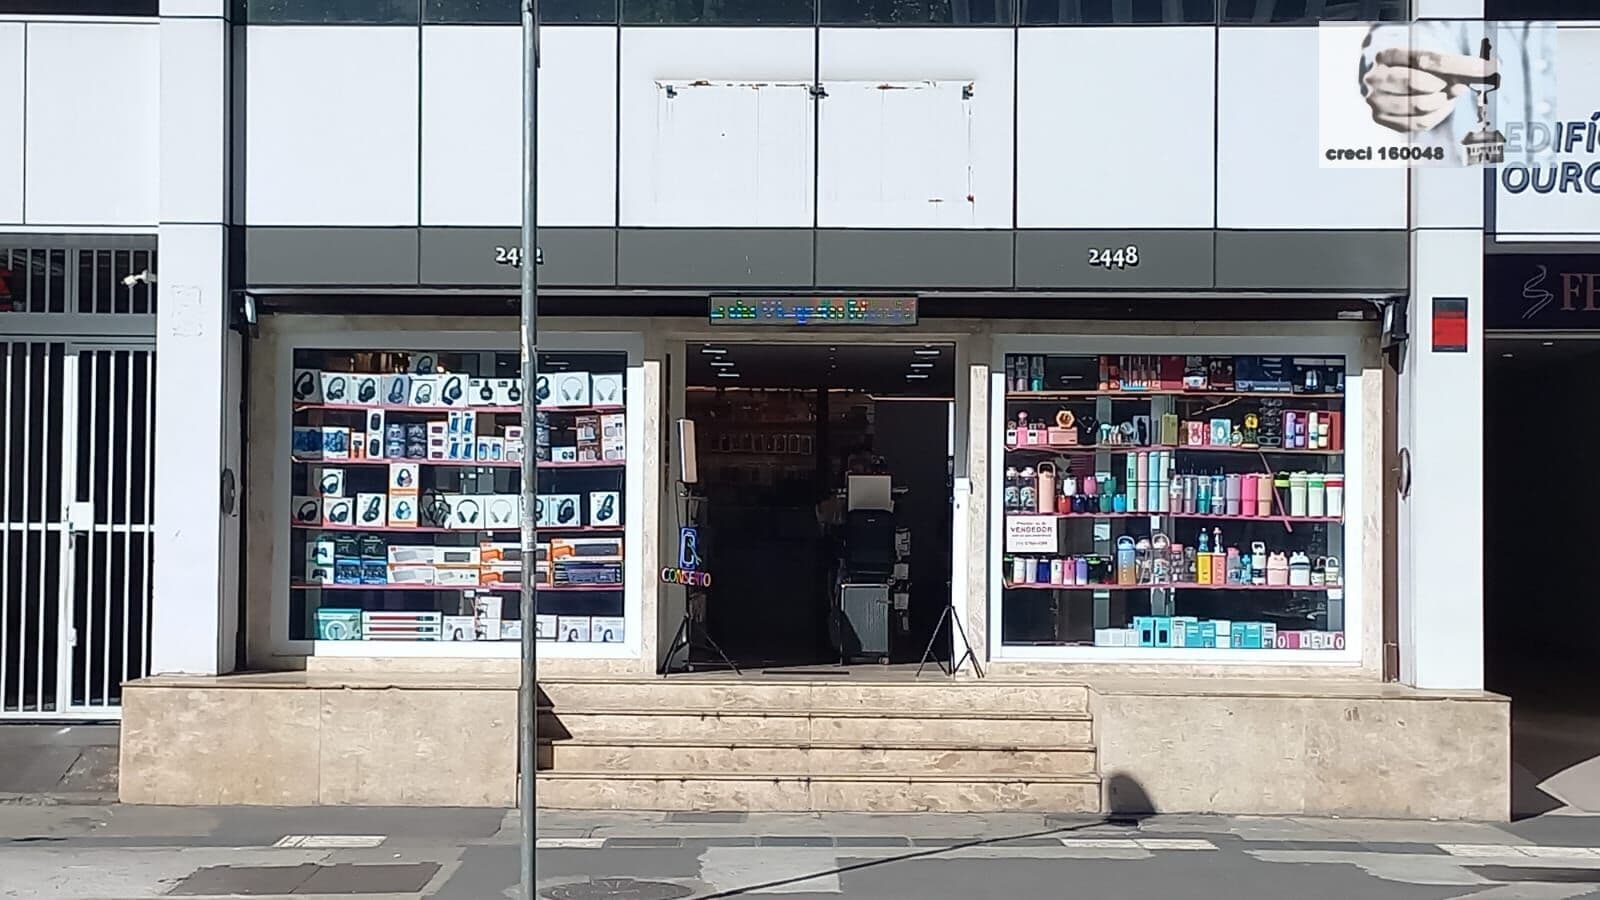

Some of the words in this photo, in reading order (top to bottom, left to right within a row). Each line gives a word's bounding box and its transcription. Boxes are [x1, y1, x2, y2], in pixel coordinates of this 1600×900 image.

[1505, 111, 1600, 153] EDIFÍ
[495, 247, 542, 266] 24
[1088, 246, 1138, 267] 2448
